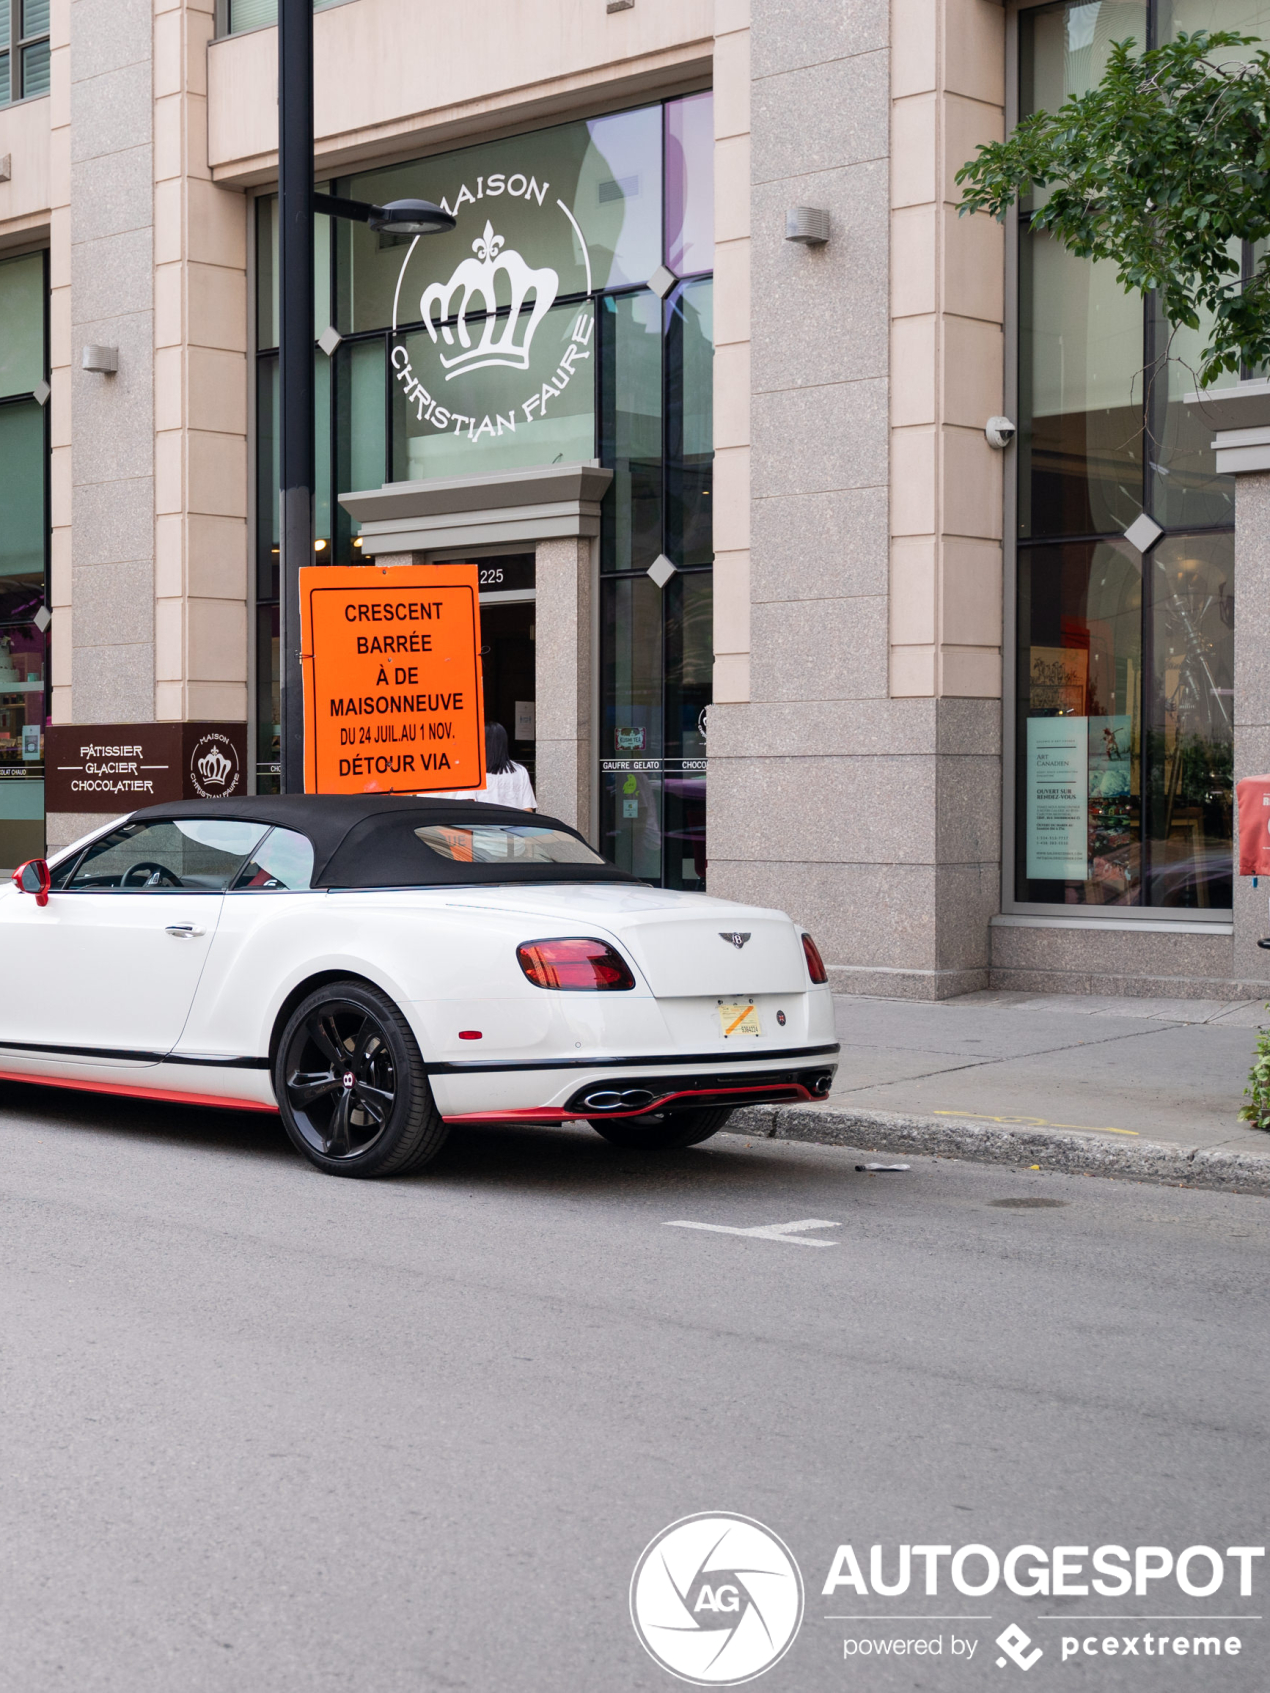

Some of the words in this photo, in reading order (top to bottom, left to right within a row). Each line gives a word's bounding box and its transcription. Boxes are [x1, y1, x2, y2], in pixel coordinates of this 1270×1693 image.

[391, 345, 516, 442] CHRISTIAN
[521, 313, 594, 422] FAURE
[480, 568, 504, 584] 225
[344, 602, 443, 623] CRESCENT
[356, 630, 433, 654] BARRÉE
[376, 663, 389, 686] À
[395, 666, 419, 685] DE
[330, 692, 464, 717] MAISONNEUVE
[199, 732, 230, 745] MAISON
[340, 727, 356, 746] DU
[359, 726, 371, 744] 24
[420, 723, 425, 741] 1
[429, 721, 456, 740] NOV.
[80, 743, 144, 760] PÂTISSIER
[85, 762, 138, 776] GLACIER
[339, 753, 415, 777] DÉTOUR
[420, 752, 451, 771] VIA
[603, 761, 630, 769] GAUFRE
[633, 761, 660, 769] GELATO
[71, 779, 154, 794] CHOCOLATIER
